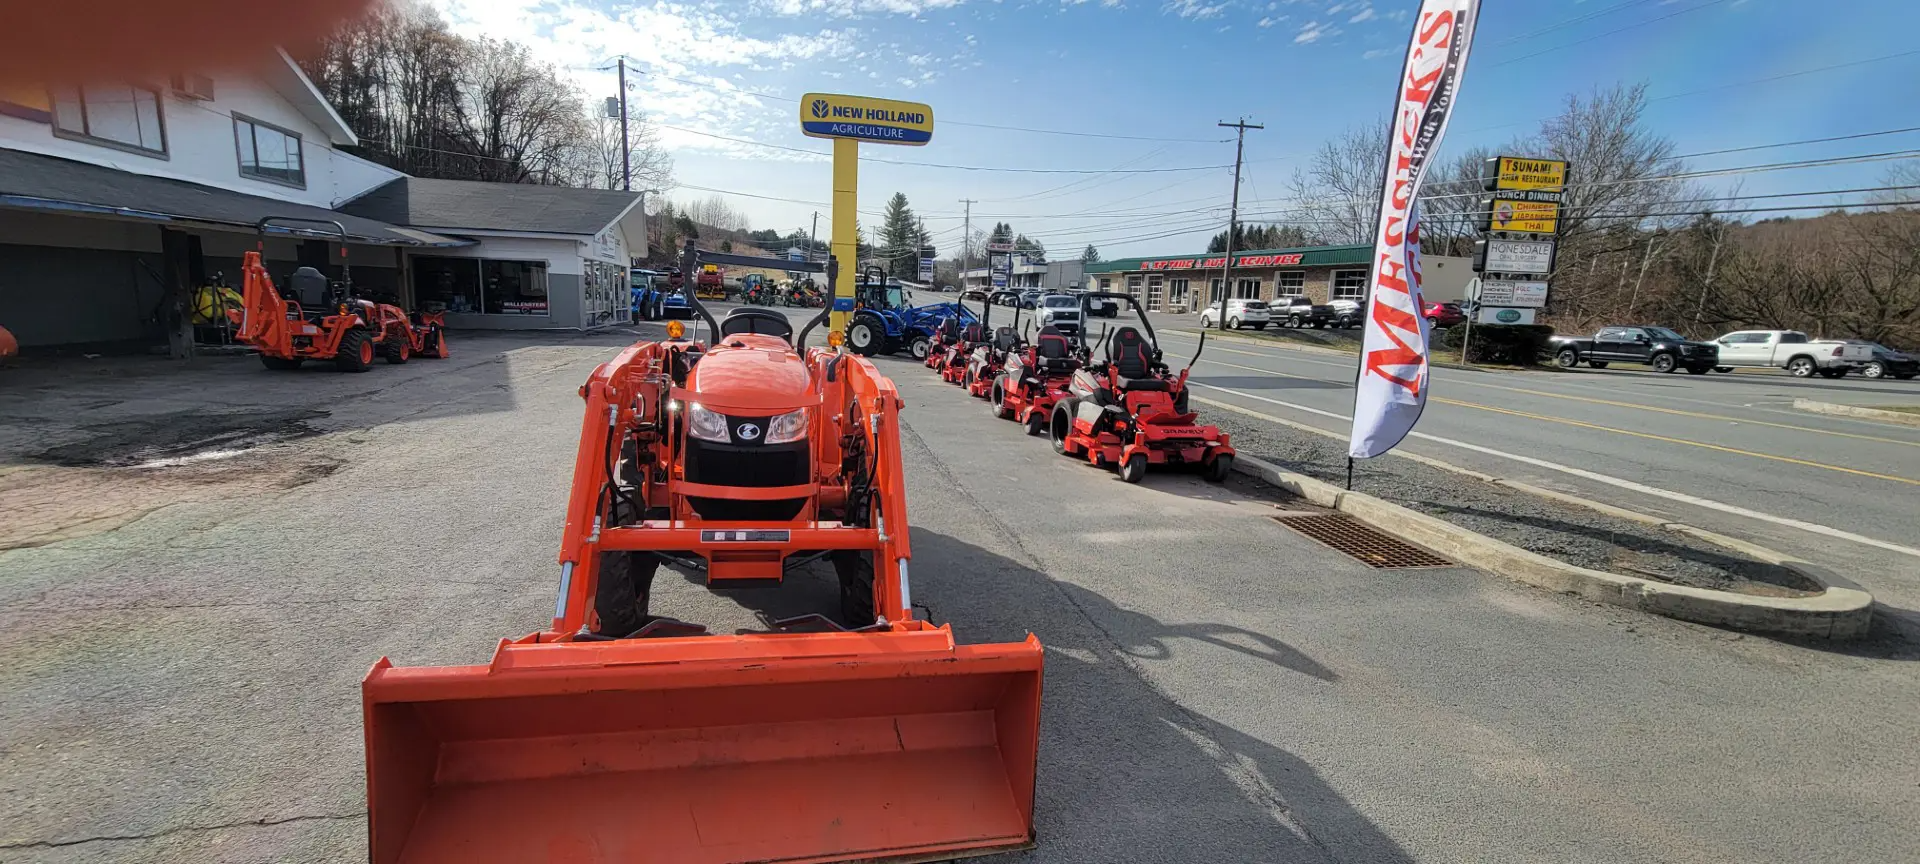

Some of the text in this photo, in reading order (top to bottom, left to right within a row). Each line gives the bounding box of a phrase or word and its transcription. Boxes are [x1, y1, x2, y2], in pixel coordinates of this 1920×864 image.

[832, 105, 925, 125] NEW HOLLAND
[1412, 119, 1439, 159] With
[1430, 75, 1454, 117] Your
[831, 123, 904, 139] AGRICULTURE
[1505, 160, 1552, 174] TSUNAMI
[1501, 173, 1560, 185] ASIAN RESTAURANT
[1496, 190, 1560, 201] LUNCH DINNER
[1524, 222, 1544, 230] THAI
[1491, 243, 1549, 255] HONESDALE
[1168, 259, 1195, 269] TIRE
[1238, 253, 1303, 267] SERVICE
